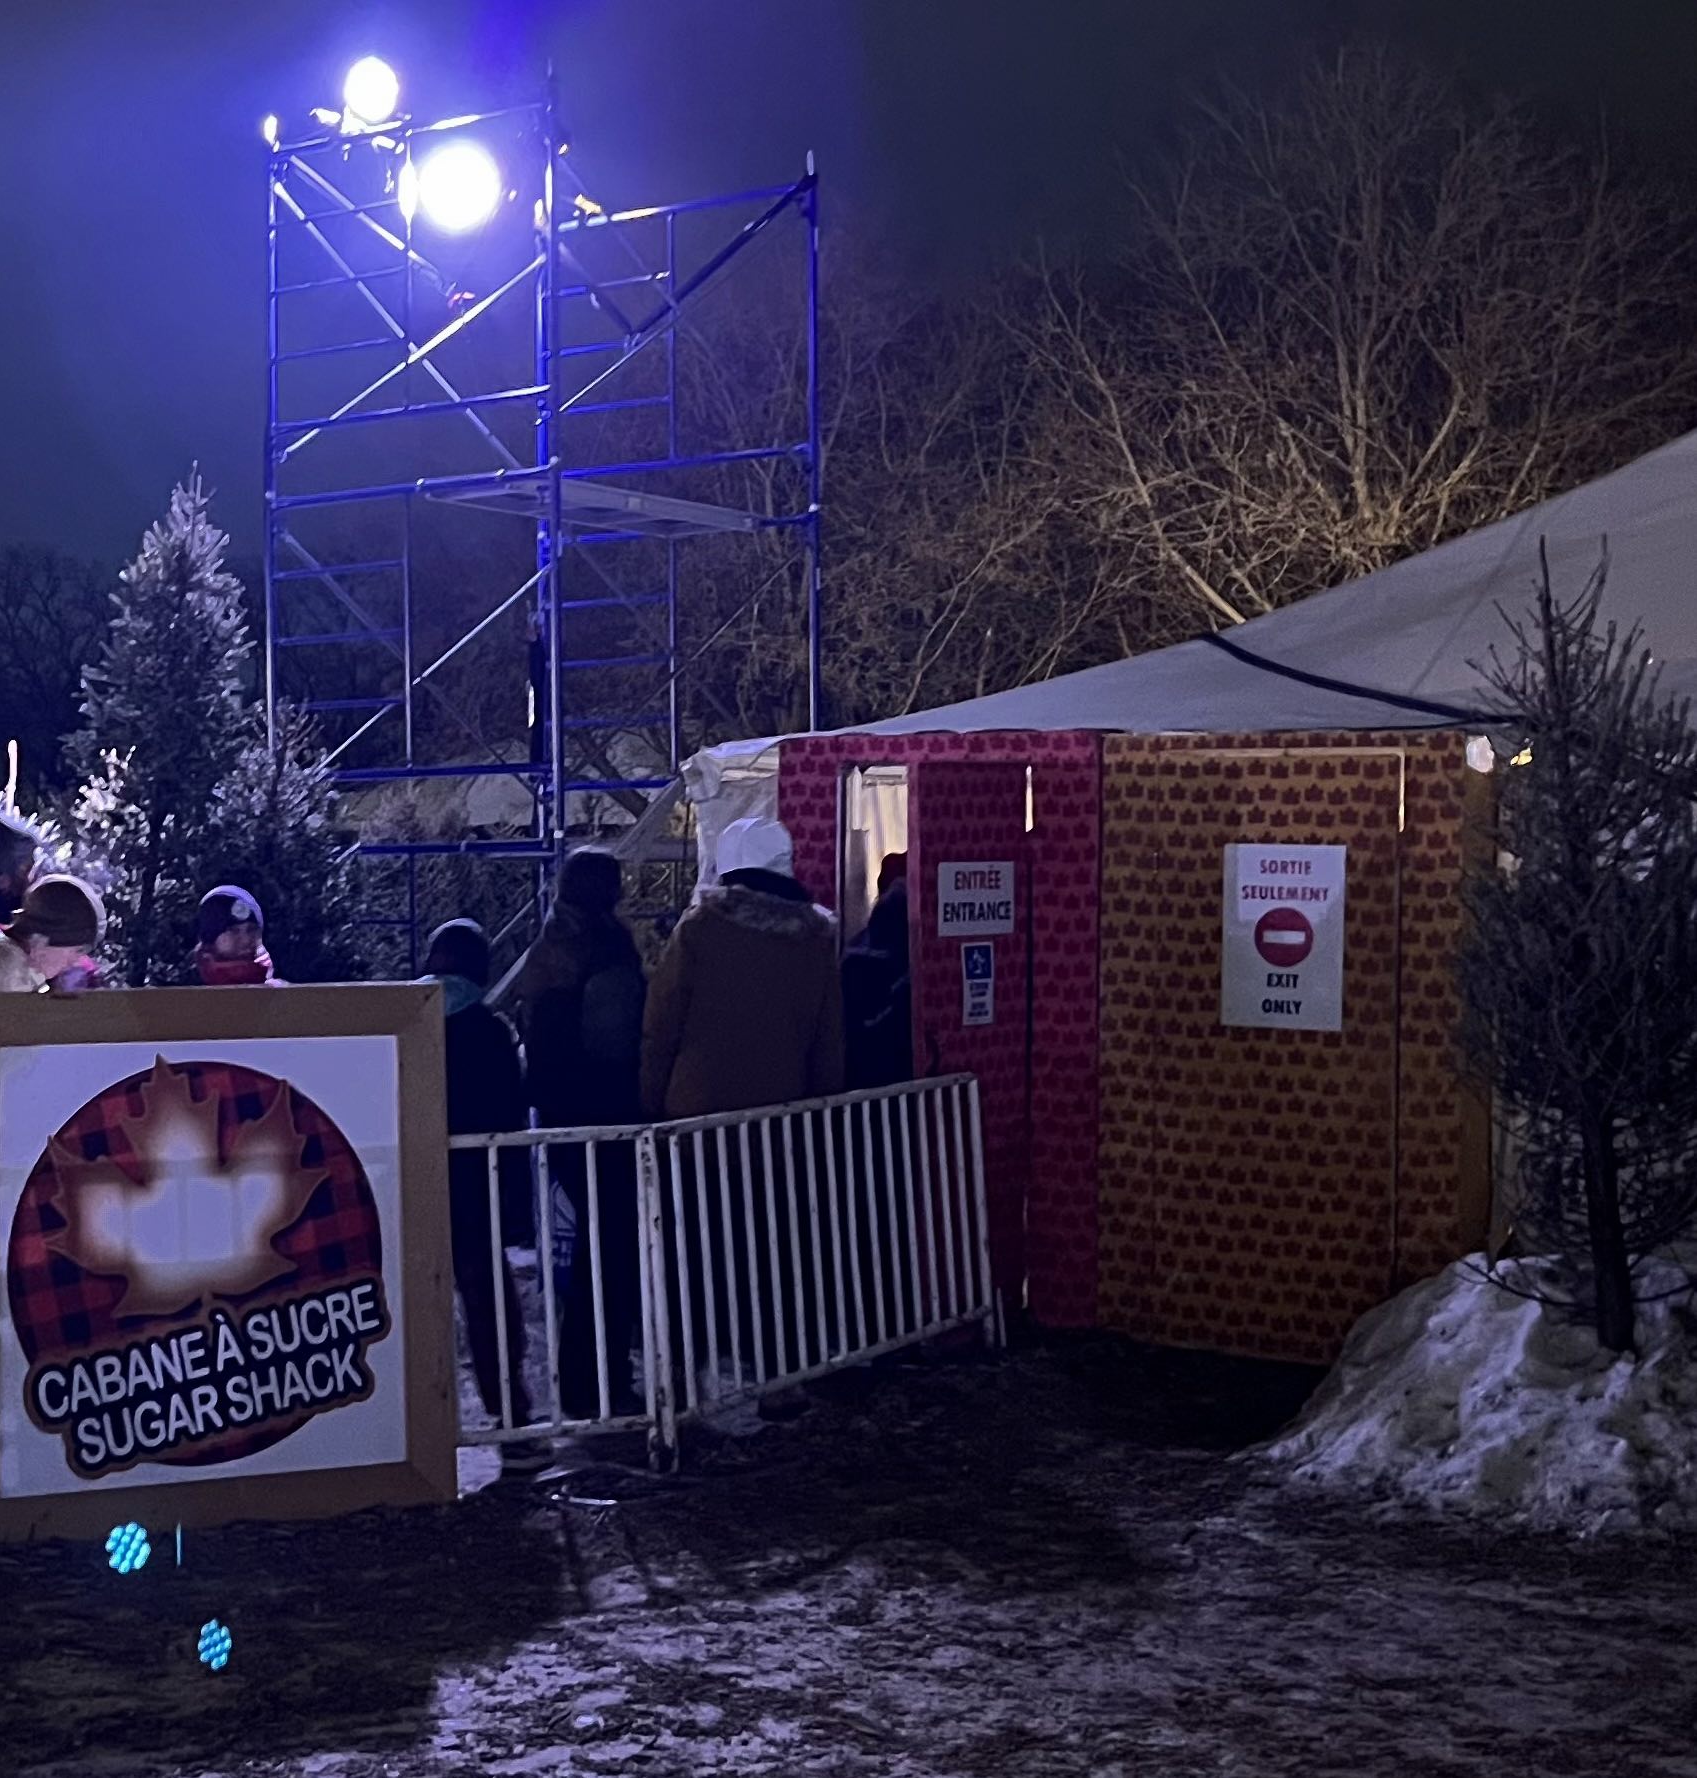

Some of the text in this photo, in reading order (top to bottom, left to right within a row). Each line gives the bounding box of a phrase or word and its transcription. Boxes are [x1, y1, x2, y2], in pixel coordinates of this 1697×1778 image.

[1259, 859, 1312, 875] SORTIE
[954, 865, 1001, 890] ENTRÉE
[1241, 884, 1329, 901] SEULEMENT
[943, 901, 1012, 923] ENTRANCE
[1266, 973, 1299, 988] EXIT
[1261, 998, 1302, 1015] ONLY
[38, 1284, 380, 1418] CABANE À SUCRE
[77, 1343, 363, 1465] SUGAR SHACK
